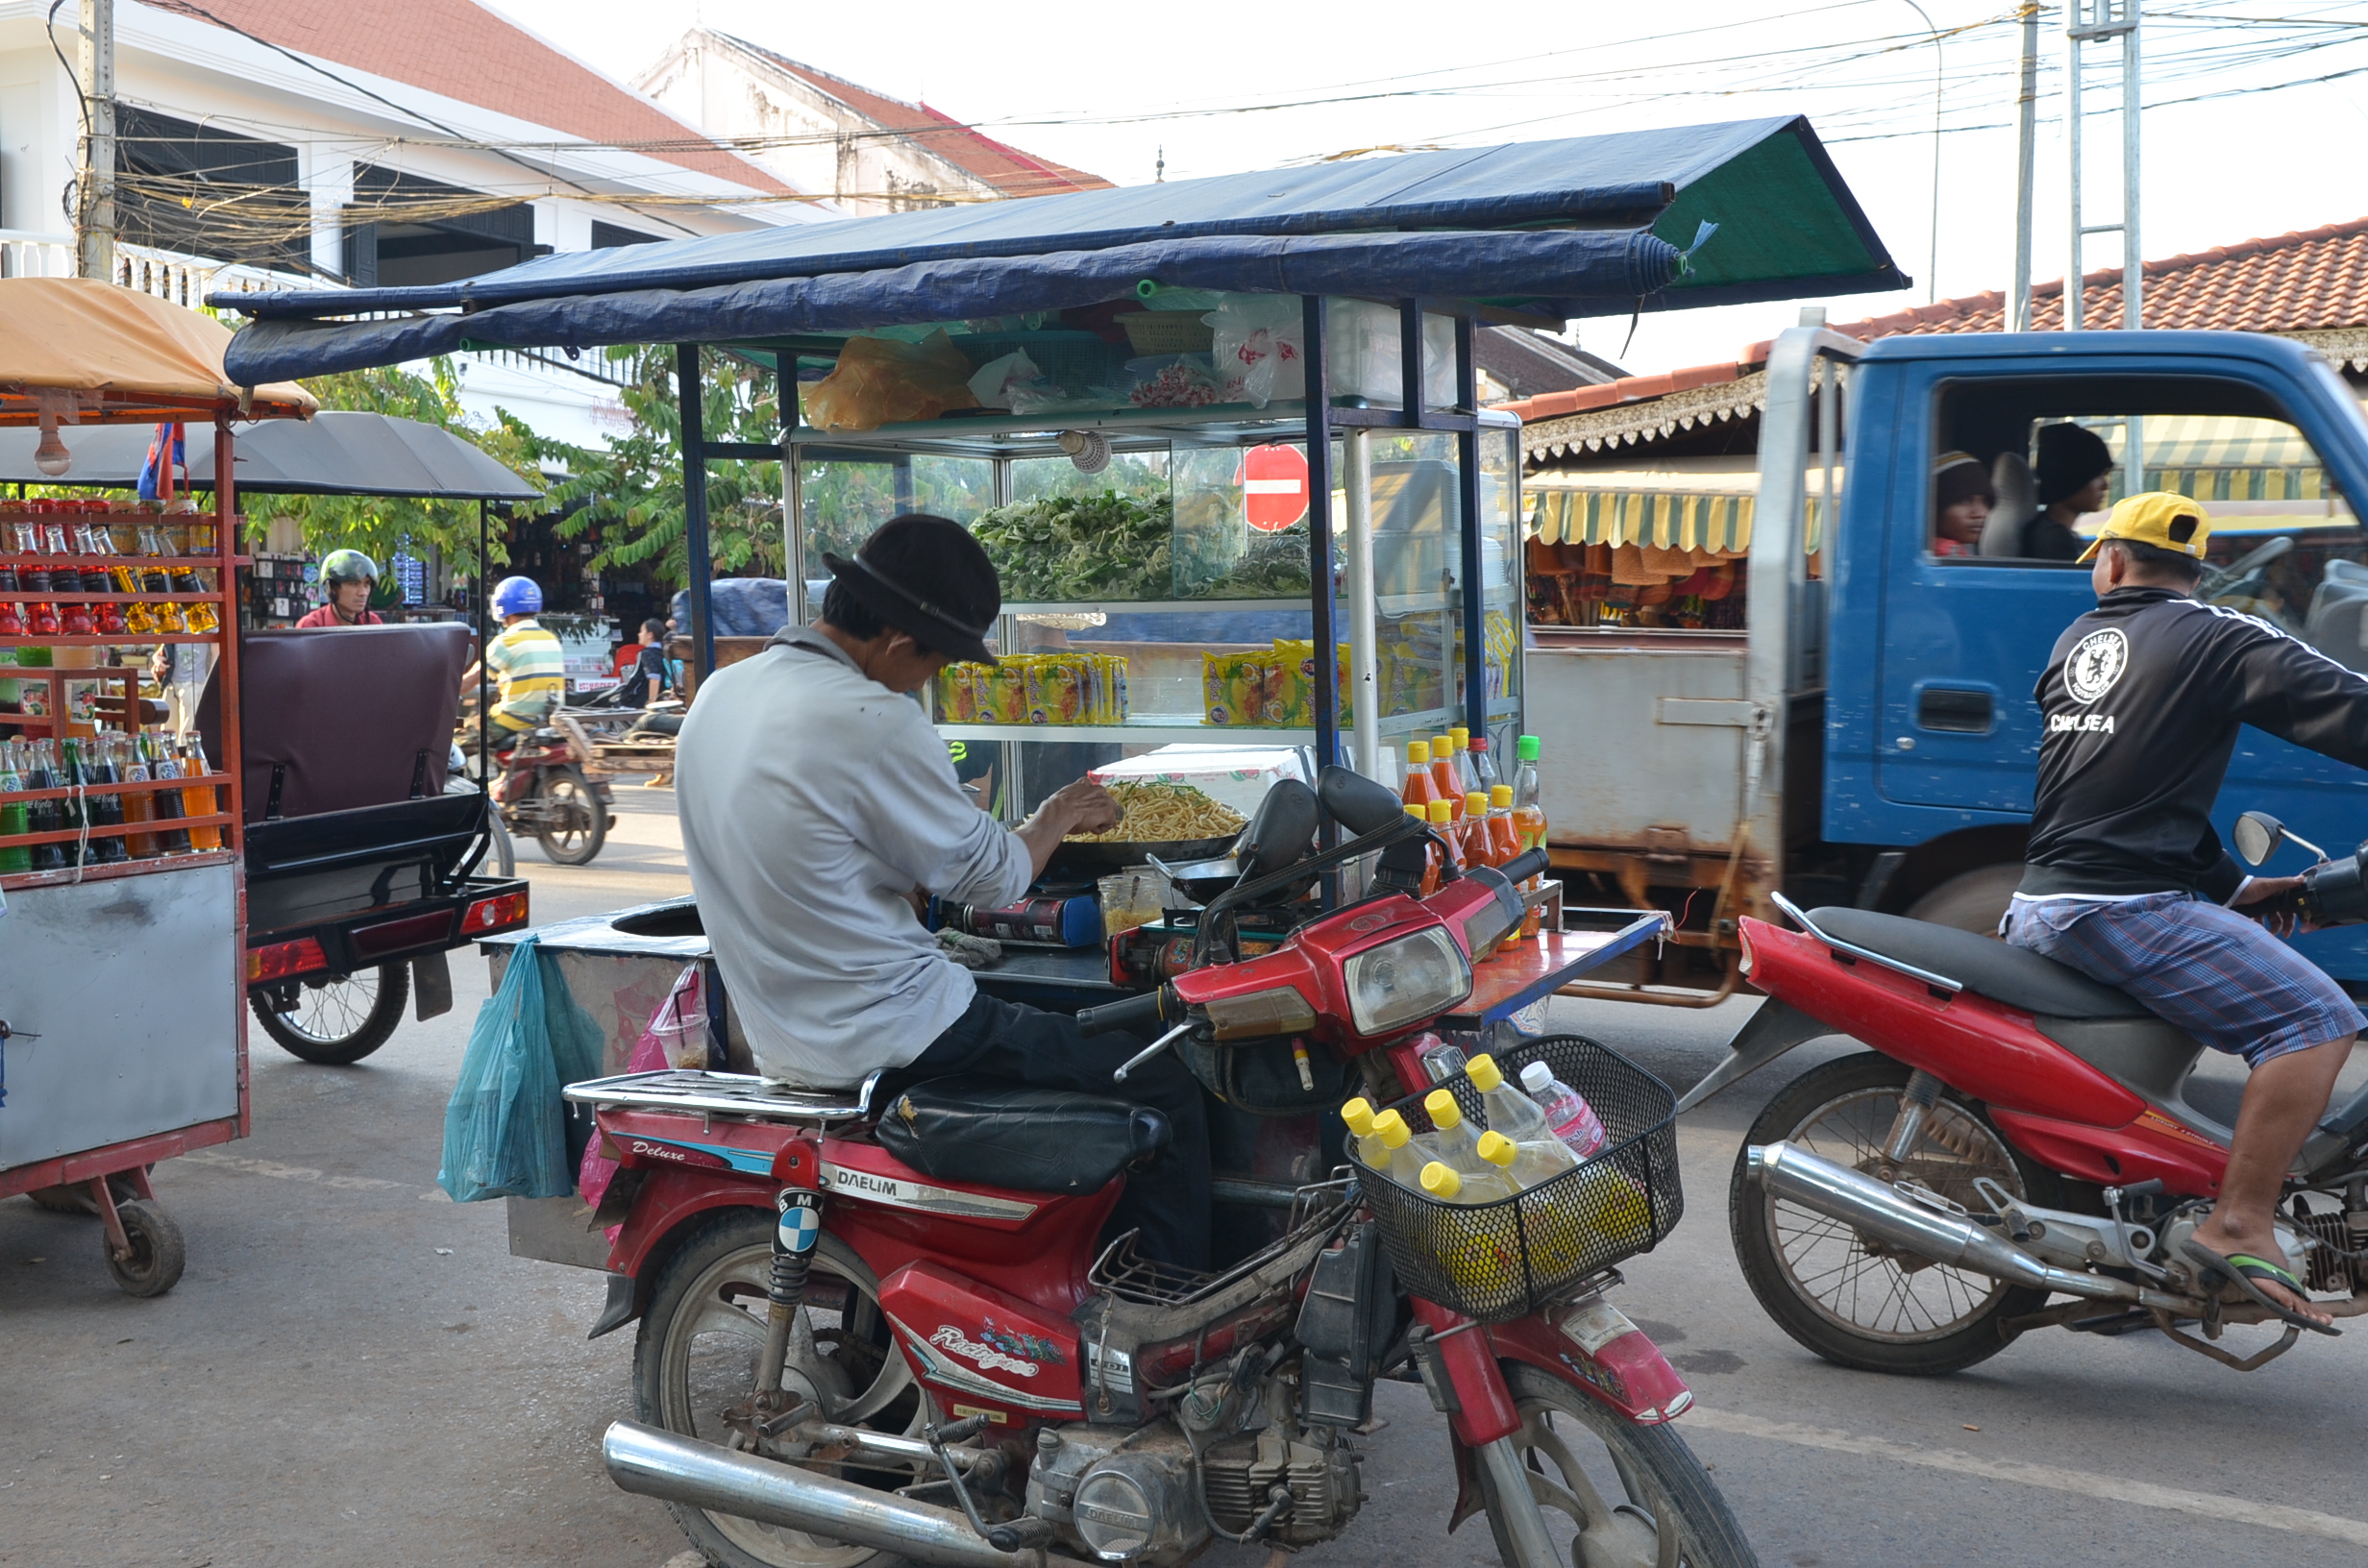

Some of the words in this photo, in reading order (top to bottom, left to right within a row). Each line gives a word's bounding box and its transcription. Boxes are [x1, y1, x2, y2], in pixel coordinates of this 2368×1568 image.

[2083, 633, 2123, 650] CHELSEA
[1562, 1128, 1584, 1144] resh
[632, 1140, 685, 1162] Deluxe
[837, 1170, 898, 1197] DAELIM
[1087, 1507, 1138, 1531] DAELIM
